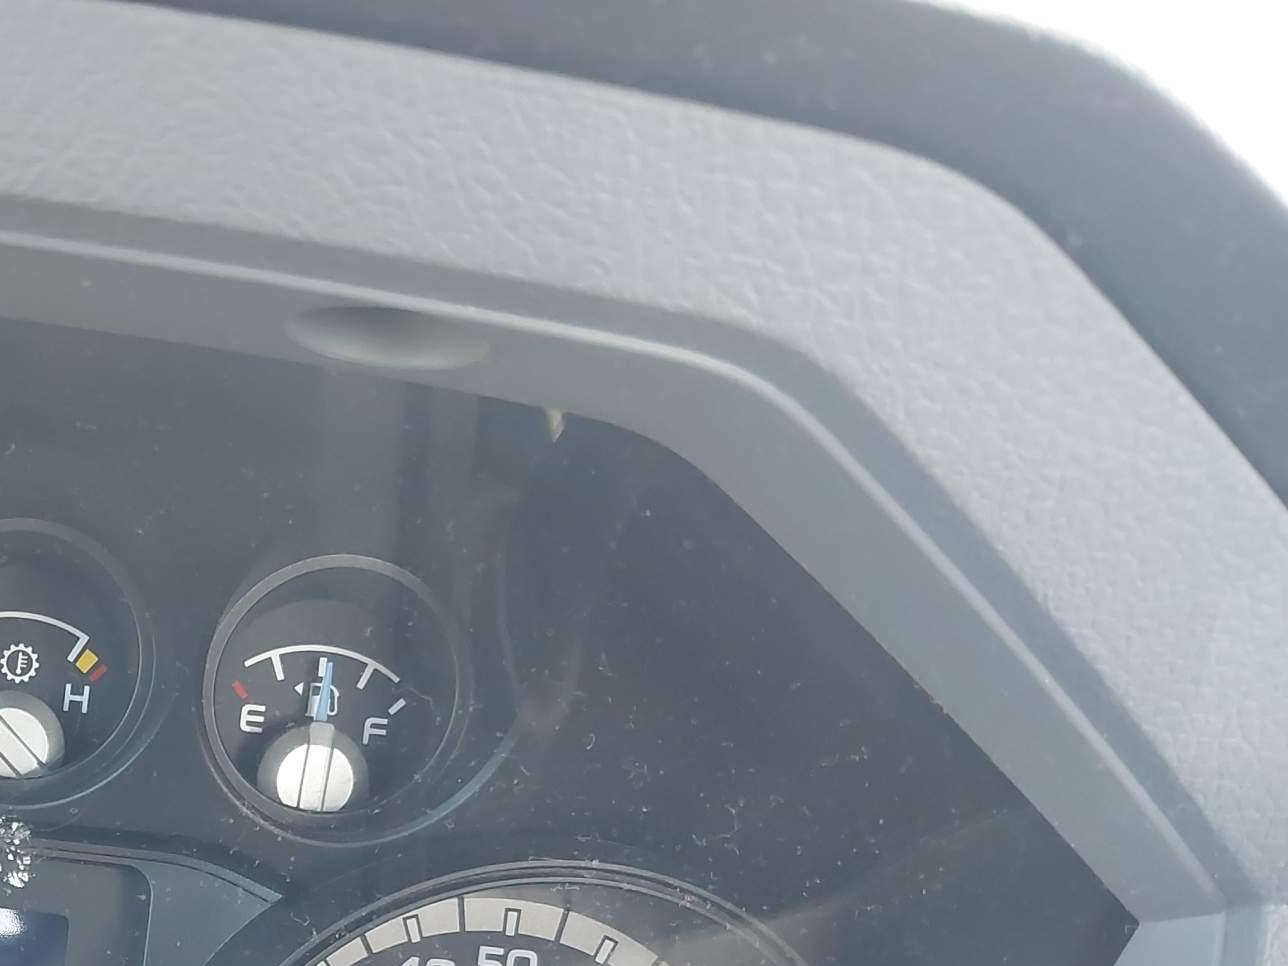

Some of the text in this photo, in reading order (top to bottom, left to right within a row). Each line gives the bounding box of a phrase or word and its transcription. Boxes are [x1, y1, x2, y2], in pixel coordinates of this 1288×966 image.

[63, 683, 91, 714] H
[239, 703, 267, 733] E
[362, 717, 389, 744] F
